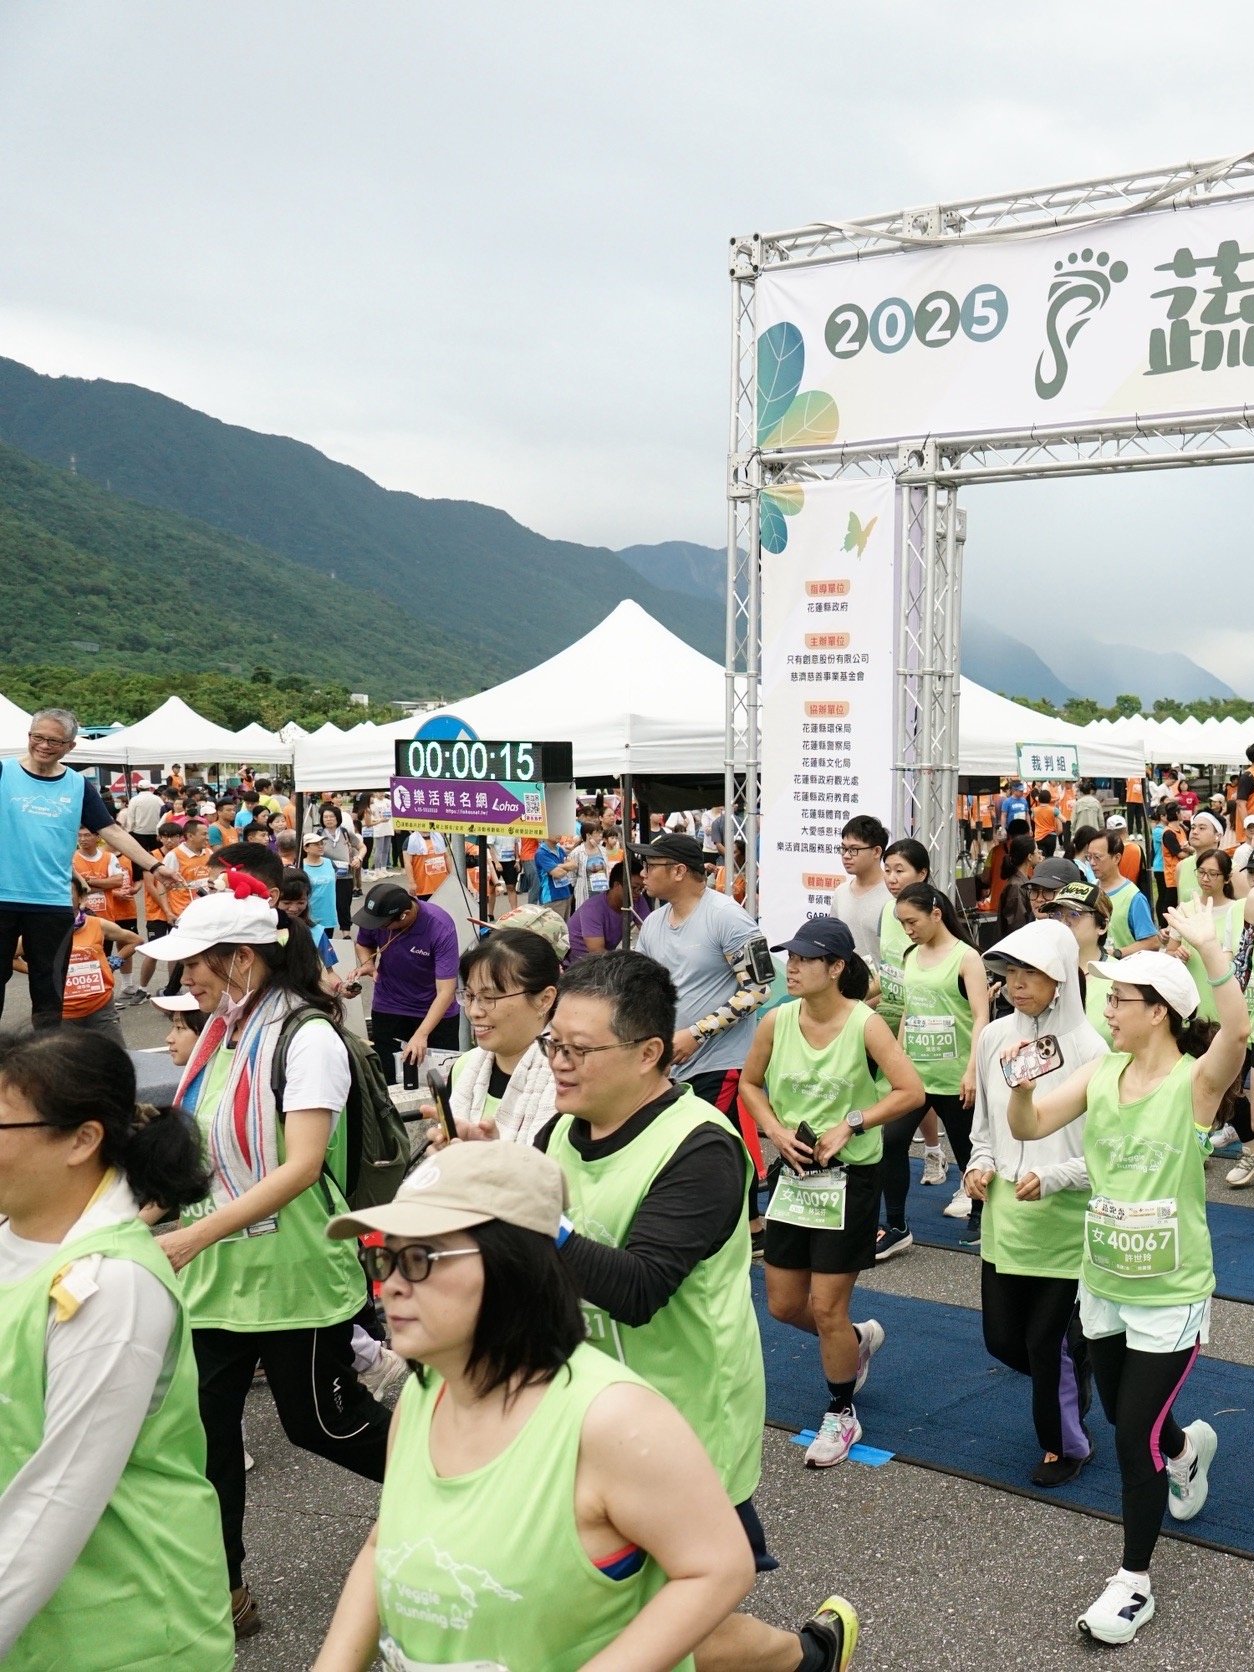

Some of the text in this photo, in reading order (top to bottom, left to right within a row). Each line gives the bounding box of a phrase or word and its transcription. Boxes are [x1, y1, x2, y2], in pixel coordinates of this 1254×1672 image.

[828, 286, 1006, 358] 2025
[809, 582, 845, 595] 指導單位
[806, 601, 849, 613] 花蓮縣政府
[809, 635, 846, 648] 主辦單位
[408, 741, 535, 781] 00:00:15
[1031, 755, 1067, 772] 裁判組
[413, 789, 519, 813] 樂活報名網 Lohas
[800, 825, 842, 837] 大愛感恩科
[807, 894, 832, 906] 華碩電
[915, 1033, 953, 1046] 40120
[780, 1188, 840, 1208] 女 40099
[1092, 1227, 1172, 1253] 女 40067
